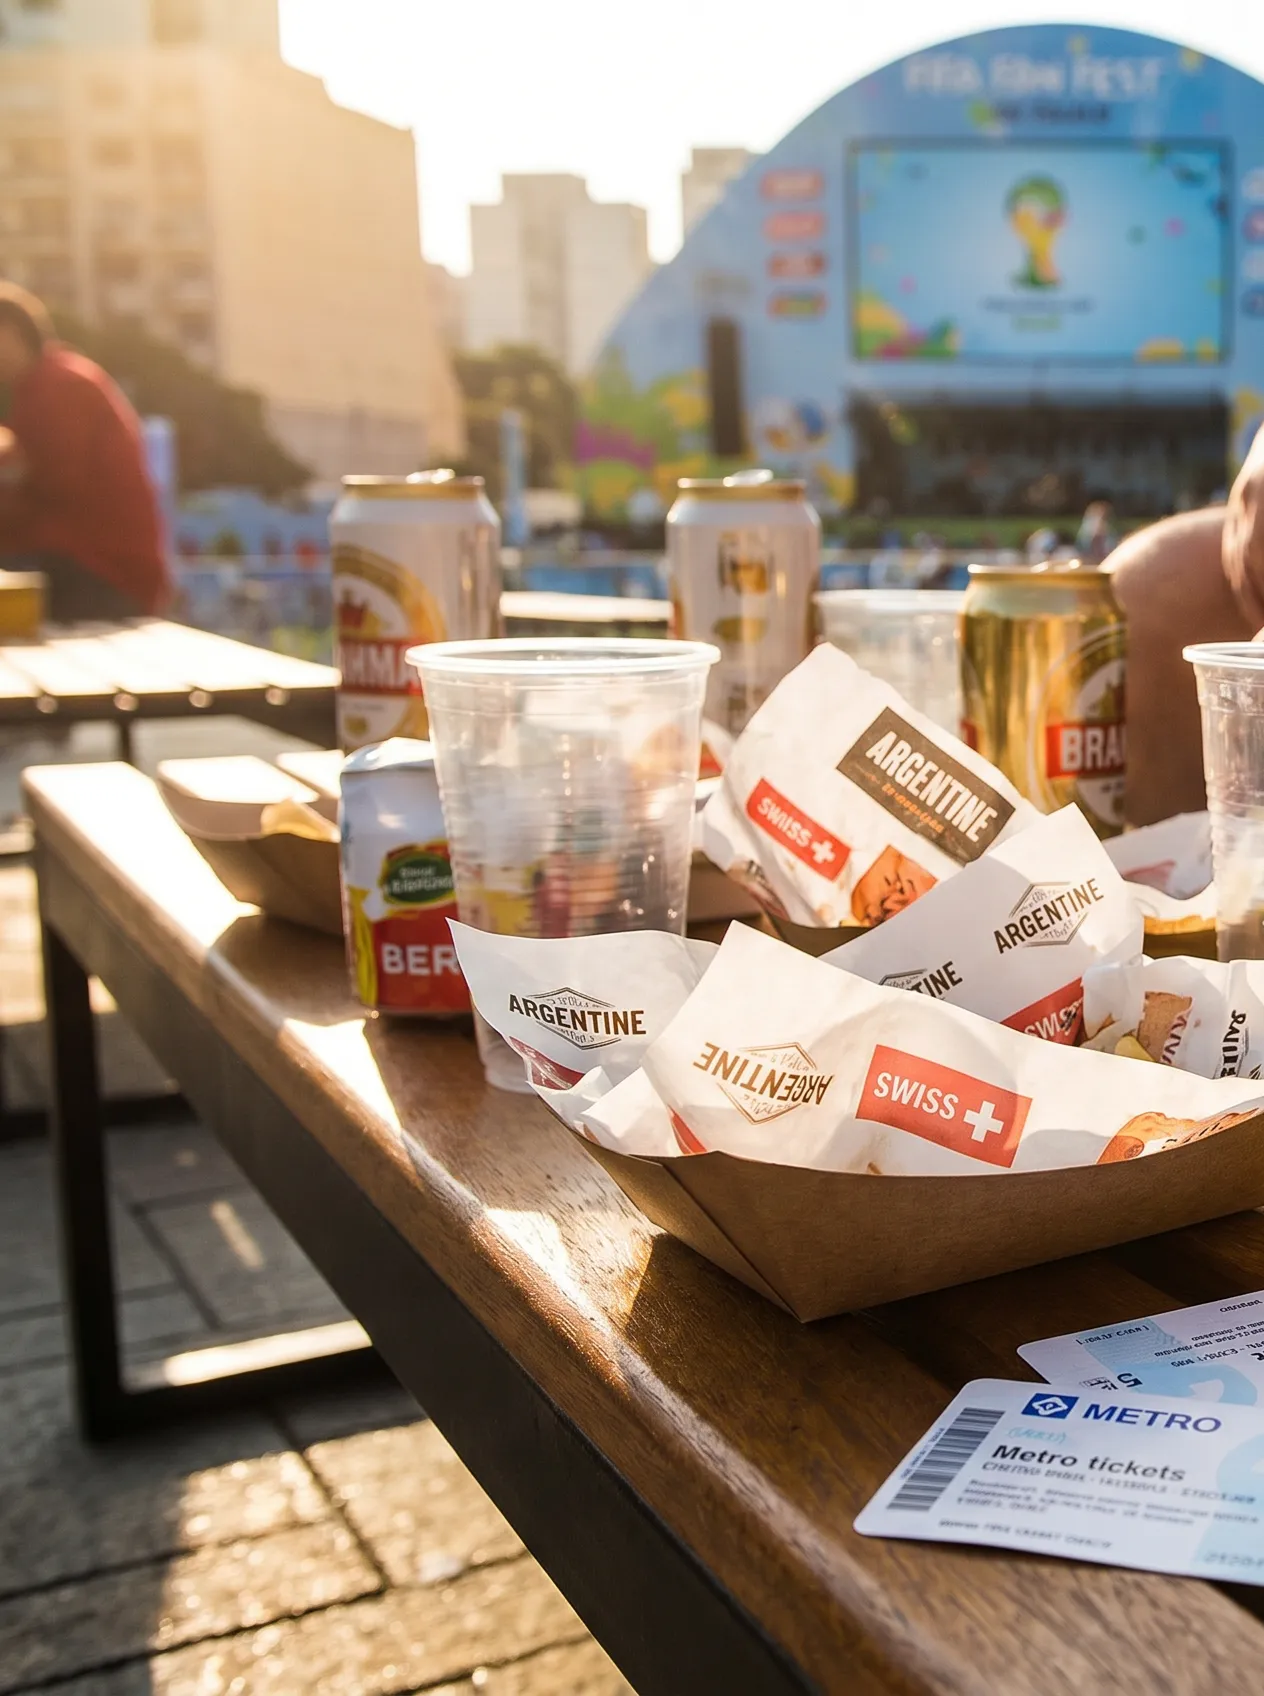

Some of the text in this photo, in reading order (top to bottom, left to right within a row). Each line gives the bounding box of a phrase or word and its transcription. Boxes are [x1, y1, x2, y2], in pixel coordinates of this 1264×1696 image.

[1061, 724, 1127, 771] BRA
[865, 730, 997, 842] ARGENTINE
[993, 878, 1104, 954] ARGENTINE
[509, 993, 647, 1036] ARGENTINE
[693, 1041, 835, 1105] ARGENTINE
[873, 1072, 959, 1121] SWISS
[1082, 1403, 1222, 1434] METRO
[991, 1444, 1187, 1482] Metro tickets
